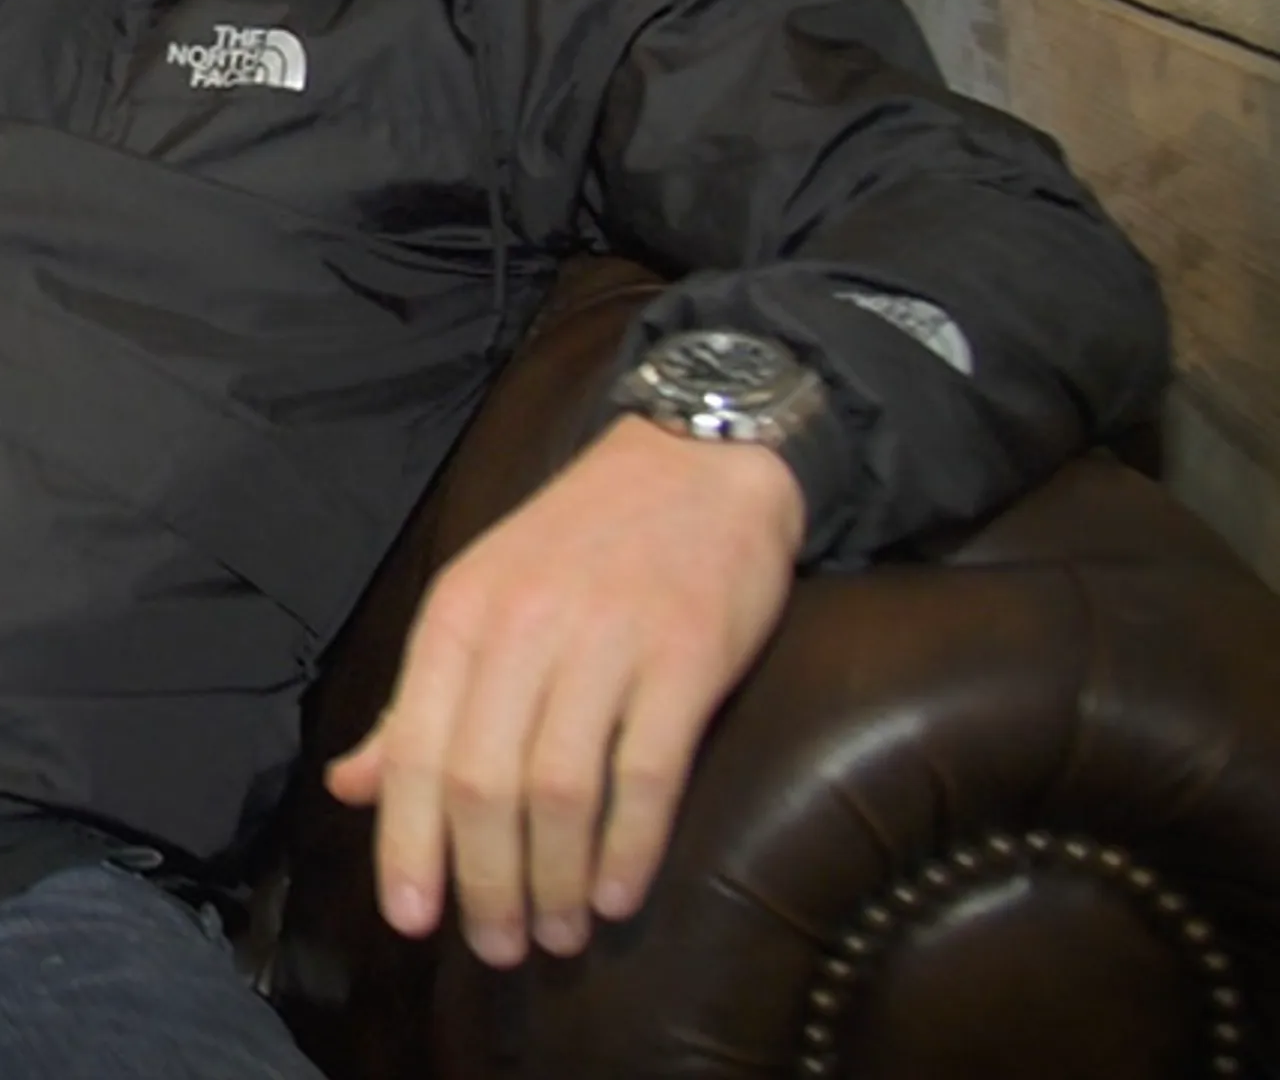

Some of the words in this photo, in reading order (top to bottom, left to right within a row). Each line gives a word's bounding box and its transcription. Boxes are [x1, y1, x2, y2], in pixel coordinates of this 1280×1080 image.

[213, 24, 267, 48] THE
[166, 41, 262, 72] NORTH
[190, 68, 255, 89] FACE
